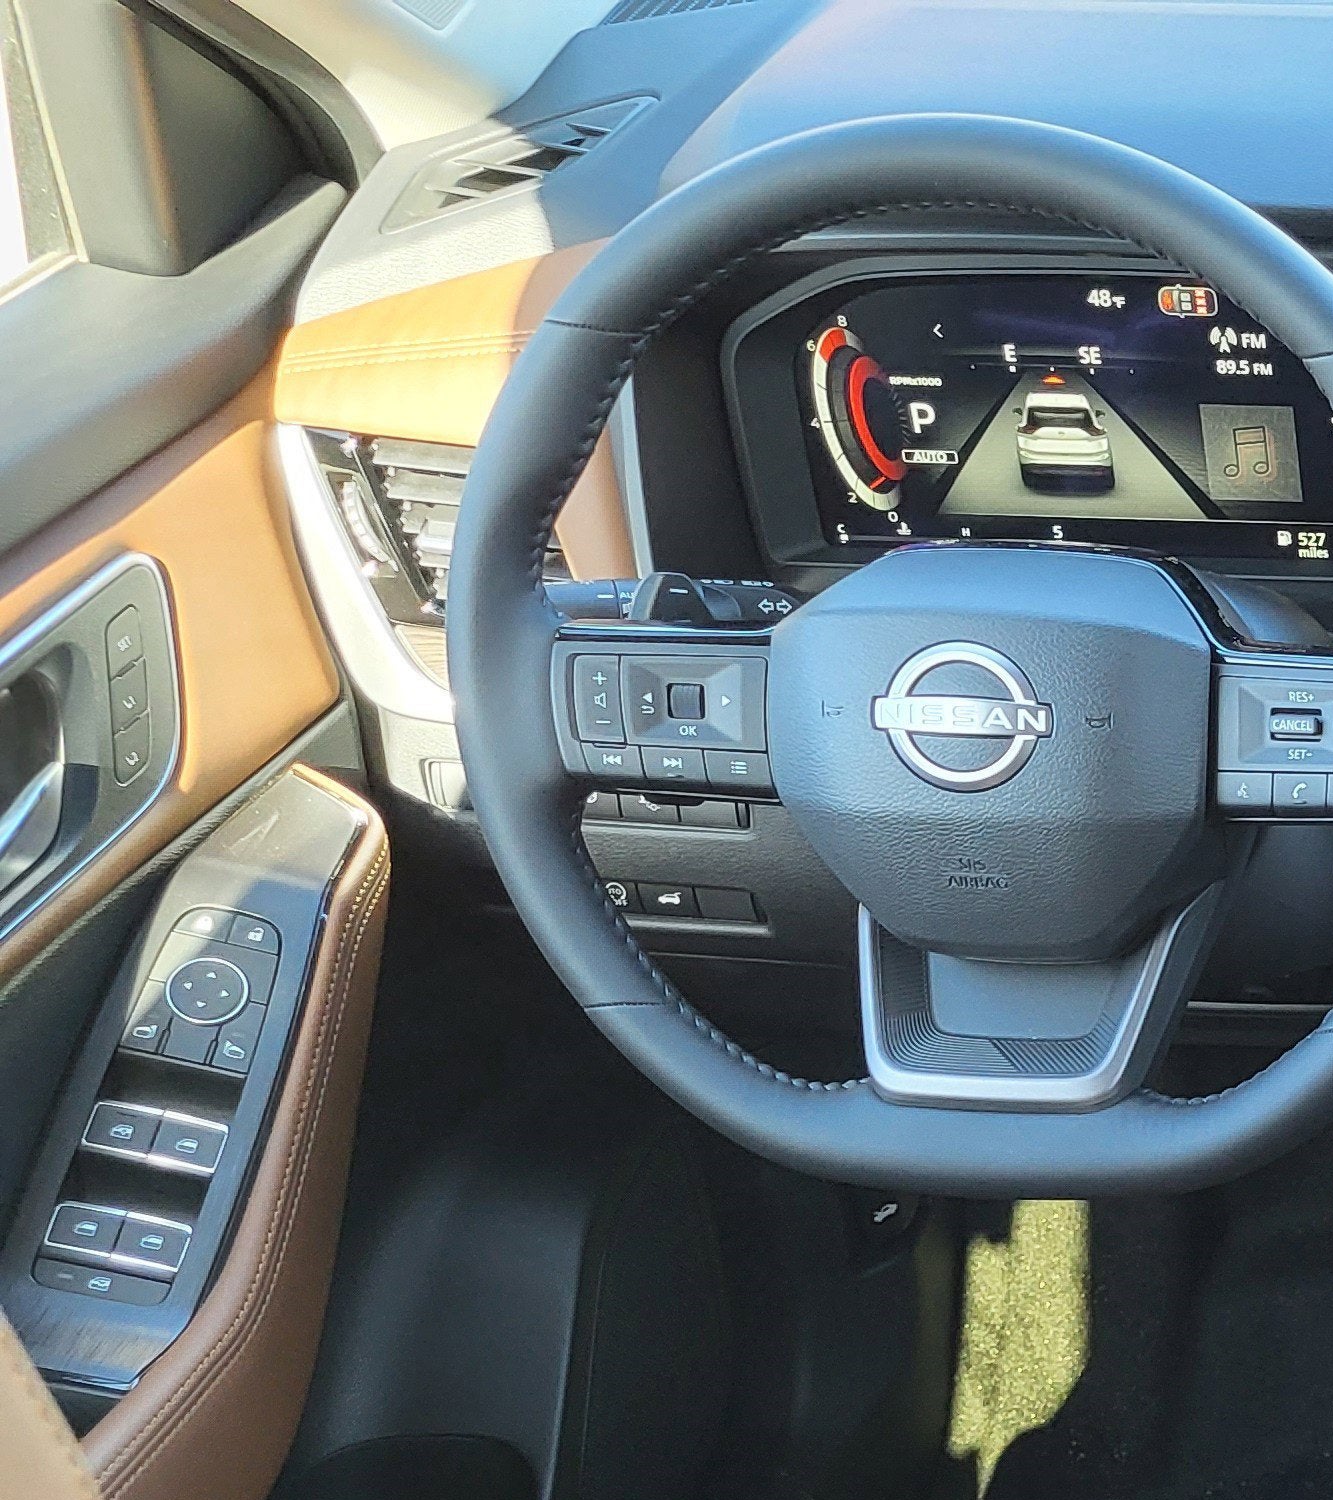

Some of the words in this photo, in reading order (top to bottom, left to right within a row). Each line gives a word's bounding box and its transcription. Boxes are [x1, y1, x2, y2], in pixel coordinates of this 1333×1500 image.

[837, 315, 847, 328] 8
[806, 339, 816, 352] 6
[1241, 333, 1267, 349] FM
[1003, 344, 1018, 363] E
[1078, 346, 1103, 365] SE
[1215, 359, 1250, 375] 89.5
[1253, 363, 1274, 376] FM
[810, 417, 821, 429] 4
[909, 402, 936, 434] P
[913, 451, 948, 463] AUTO
[847, 491, 859, 503] 2
[887, 511, 899, 523] 0
[836, 523, 846, 534] C
[961, 527, 971, 537] H
[1297, 532, 1326, 547] 527
[1297, 547, 1330, 559] miles
[1288, 691, 1315, 704] RES+
[879, 703, 1046, 732] NISSAN
[678, 725, 698, 737] OK
[1271, 718, 1313, 732] CANCEL
